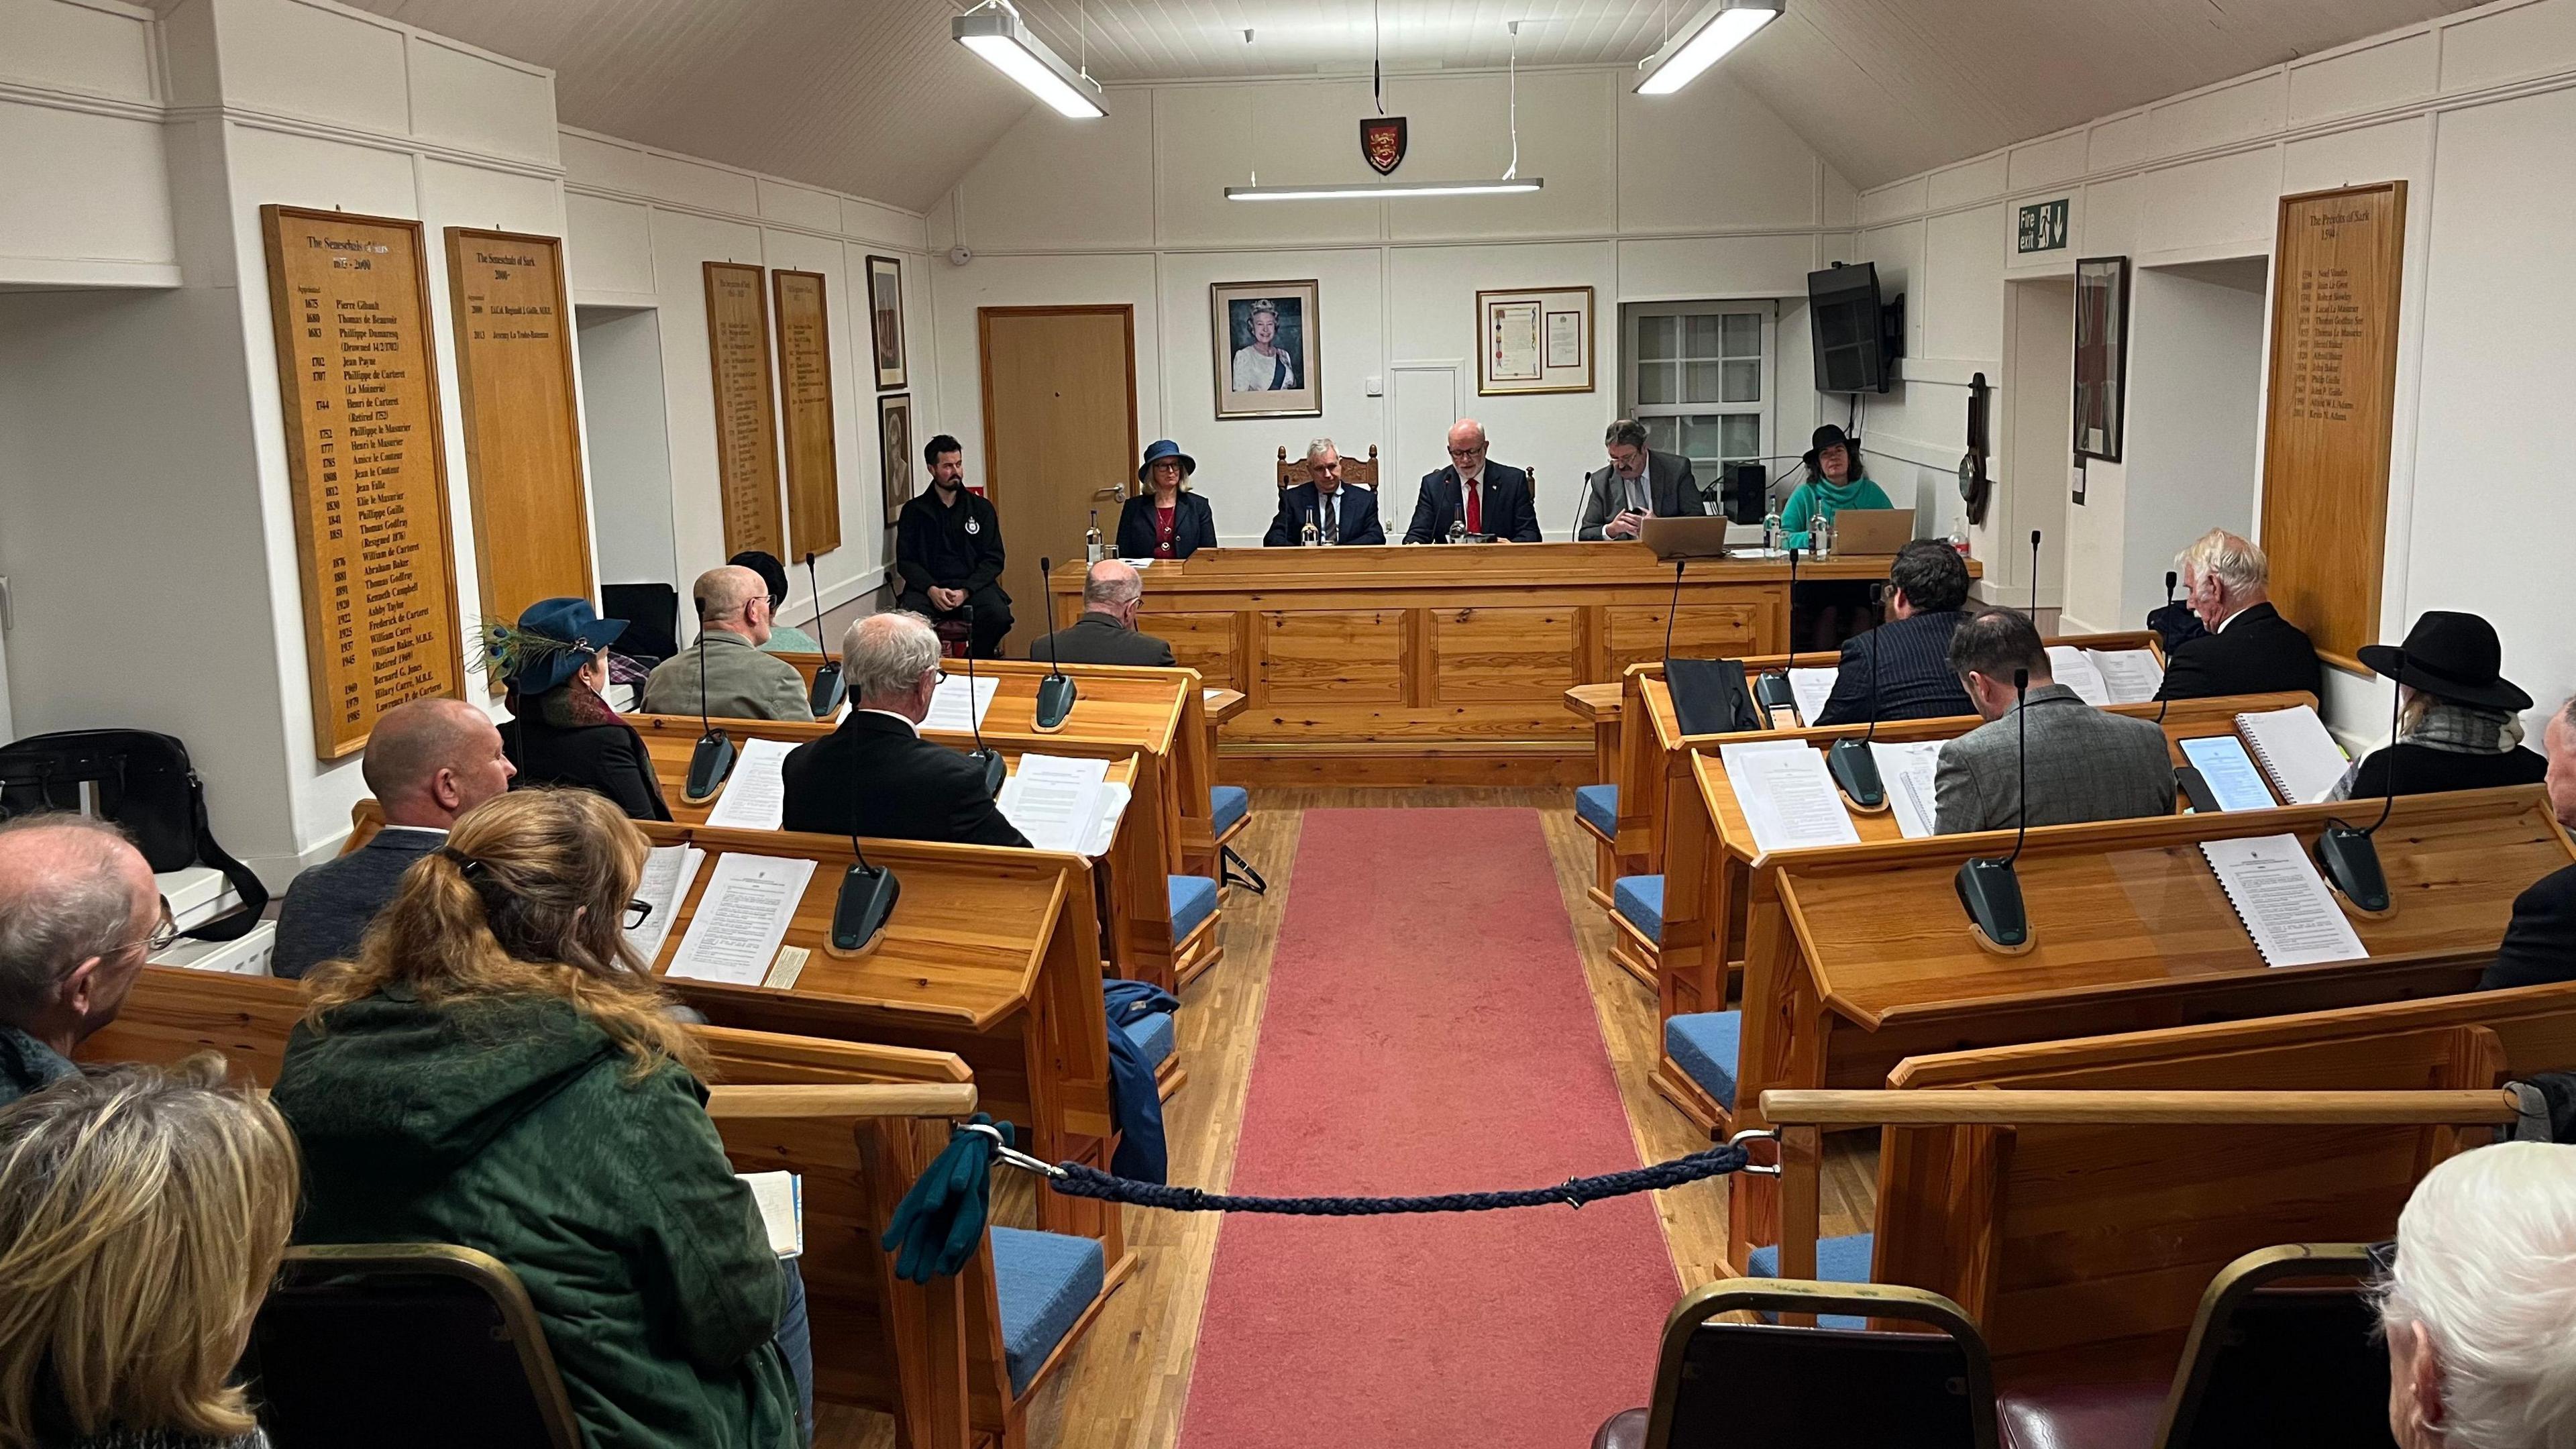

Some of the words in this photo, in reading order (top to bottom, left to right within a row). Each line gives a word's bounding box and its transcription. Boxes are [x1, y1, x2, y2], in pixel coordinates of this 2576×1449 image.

[2021, 211, 2035, 229] Fire
[2310, 215, 2320, 225] The
[2355, 210, 2369, 221] Sark
[307, 236, 322, 248] The
[2020, 231, 2033, 250] exit
[354, 260, 370, 270] 2000
[476, 253, 487, 263] The
[523, 256, 535, 266] Sark
[305, 299, 319, 309] 1675
[336, 300, 355, 309] Pierre
[307, 313, 320, 323] 1680
[338, 314, 362, 323] Thomas
[364, 315, 371, 323] de
[308, 328, 321, 337] 1683
[312, 357, 325, 366] 1702
[343, 357, 356, 367] Jean
[359, 357, 376, 368] Payne
[313, 372, 325, 381] 1707
[373, 370, 380, 378] de
[381, 370, 405, 378] Carteret
[345, 384, 356, 394] (La
[316, 400, 329, 410] 1744
[347, 398, 364, 409] Henri
[366, 398, 373, 407] de
[374, 397, 398, 407] Carteret
[349, 413, 373, 422] (Retired
[379, 425, 384, 433] le
[385, 424, 411, 433] Masurier
[321, 443, 333, 453] 1777
[352, 441, 369, 451] Henri
[370, 440, 376, 448] le
[378, 437, 403, 447] Masurier
[323, 458, 335, 468] 1785
[374, 453, 378, 462] le
[355, 469, 368, 480] Jean
[370, 468, 375, 476] le
[325, 486, 339, 496] 1812
[356, 483, 370, 494] Jean
[357, 496, 369, 506] Elie
[371, 496, 376, 504] le
[329, 515, 341, 525] 1841
[387, 504, 404, 515] Guille
[330, 529, 343, 540] 1851
[360, 523, 383, 534] Thomas
[362, 535, 390, 549] (Resigned
[333, 557, 346, 568] 1876
[363, 550, 386, 561] William
[388, 548, 395, 557] de
[396, 543, 419, 554] Carteret
[364, 564, 391, 576] Abraham
[392, 559, 409, 570] Baker
[336, 585, 348, 596] 1891
[365, 578, 388, 589] Thomas
[337, 599, 350, 610] 1920
[366, 590, 390, 603] Kenneth
[392, 582, 418, 596] Campbell
[338, 613, 351, 625] 1922
[368, 605, 385, 616] Ashby
[387, 601, 404, 612] Taylor
[339, 627, 352, 639] 1925
[369, 616, 397, 631] Frederick
[398, 612, 405, 622] de
[407, 607, 429, 619] Carteret
[341, 641, 354, 653] 1937
[370, 631, 394, 643] William
[342, 655, 355, 667] 1945
[372, 644, 395, 657] William
[373, 657, 396, 672] (Retired
[345, 683, 358, 695] 1969
[374, 672, 398, 686] Bernard
[408, 663, 422, 675] Jones
[345, 697, 359, 709] 1979
[376, 686, 394, 699] Hilary
[347, 710, 360, 723] 1985
[376, 697, 403, 712] Lawrence
[405, 693, 411, 702] P.
[412, 690, 419, 699] de
[420, 683, 441, 696] Carteret
